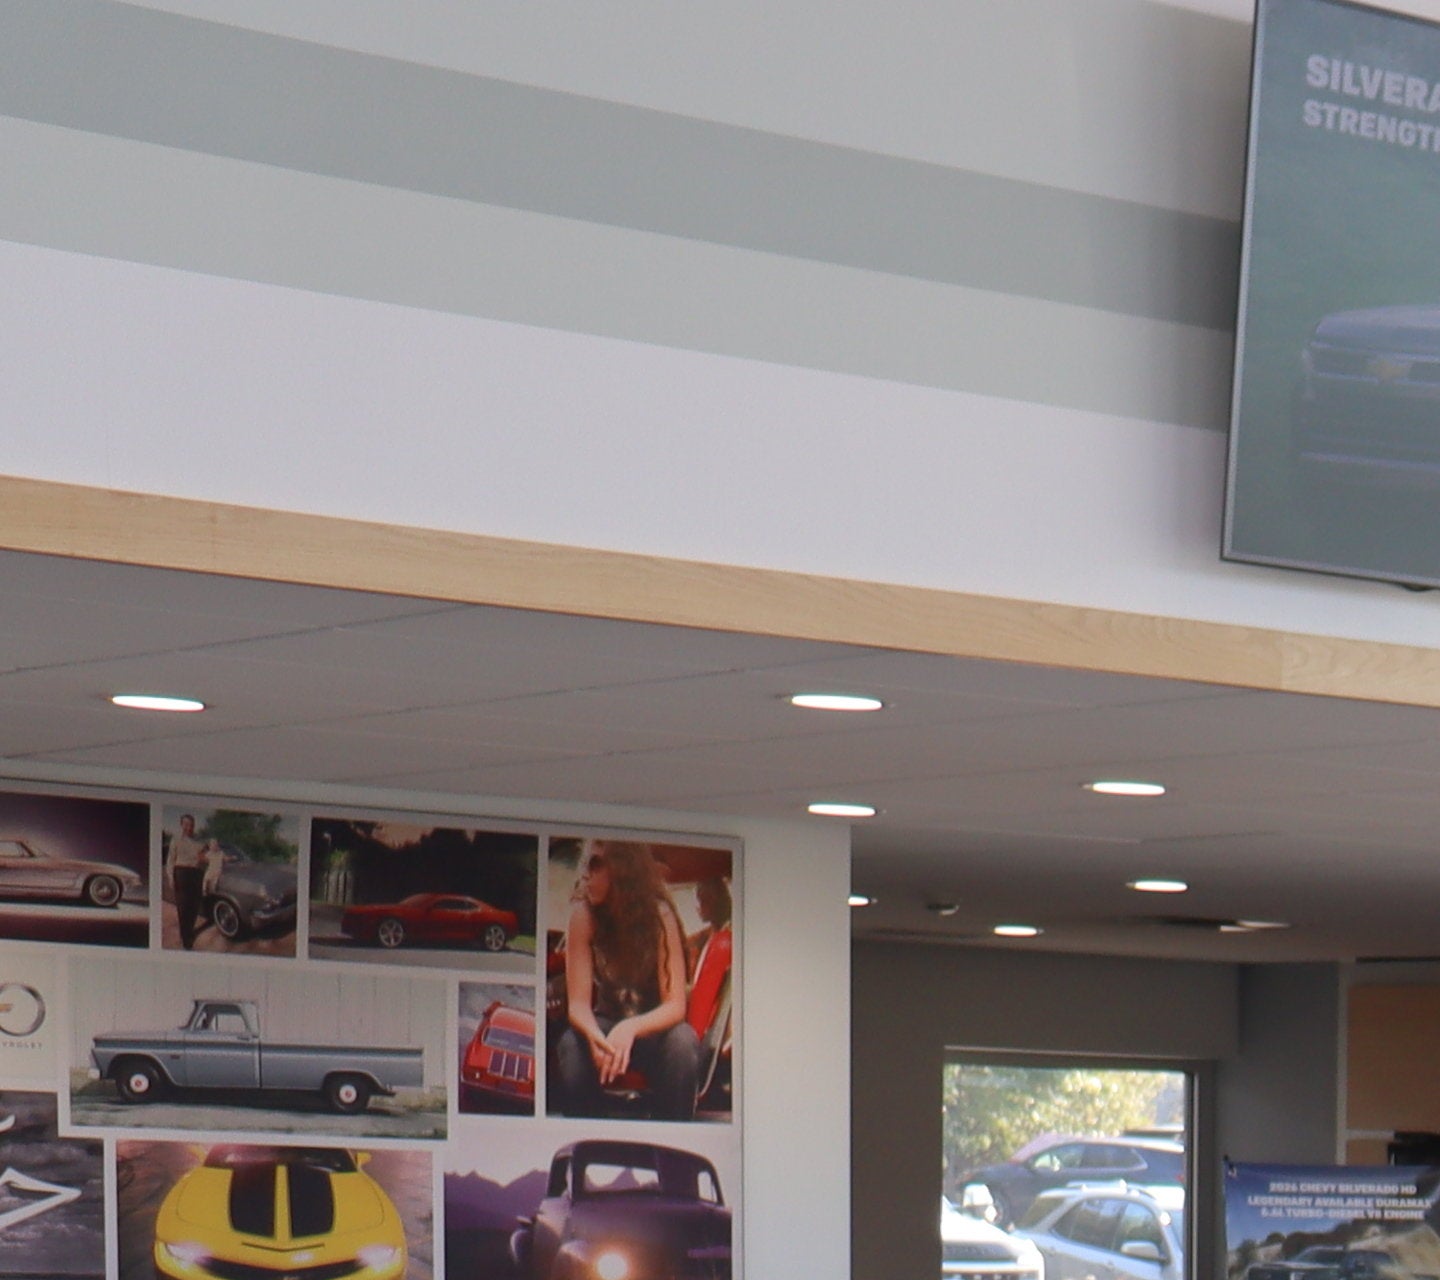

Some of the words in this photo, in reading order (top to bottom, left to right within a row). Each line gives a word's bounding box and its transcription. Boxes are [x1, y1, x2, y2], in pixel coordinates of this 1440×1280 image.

[1300, 1182, 1337, 1194] CHEVY
[1339, 1183, 1399, 1195] SILVERADO
[1400, 1184, 1417, 1195] HD
[1248, 1195, 1313, 1208] LEGENDARY
[1314, 1196, 1375, 1208] AVAILABLE
[1383, 1209, 1425, 1220] ENGINE
